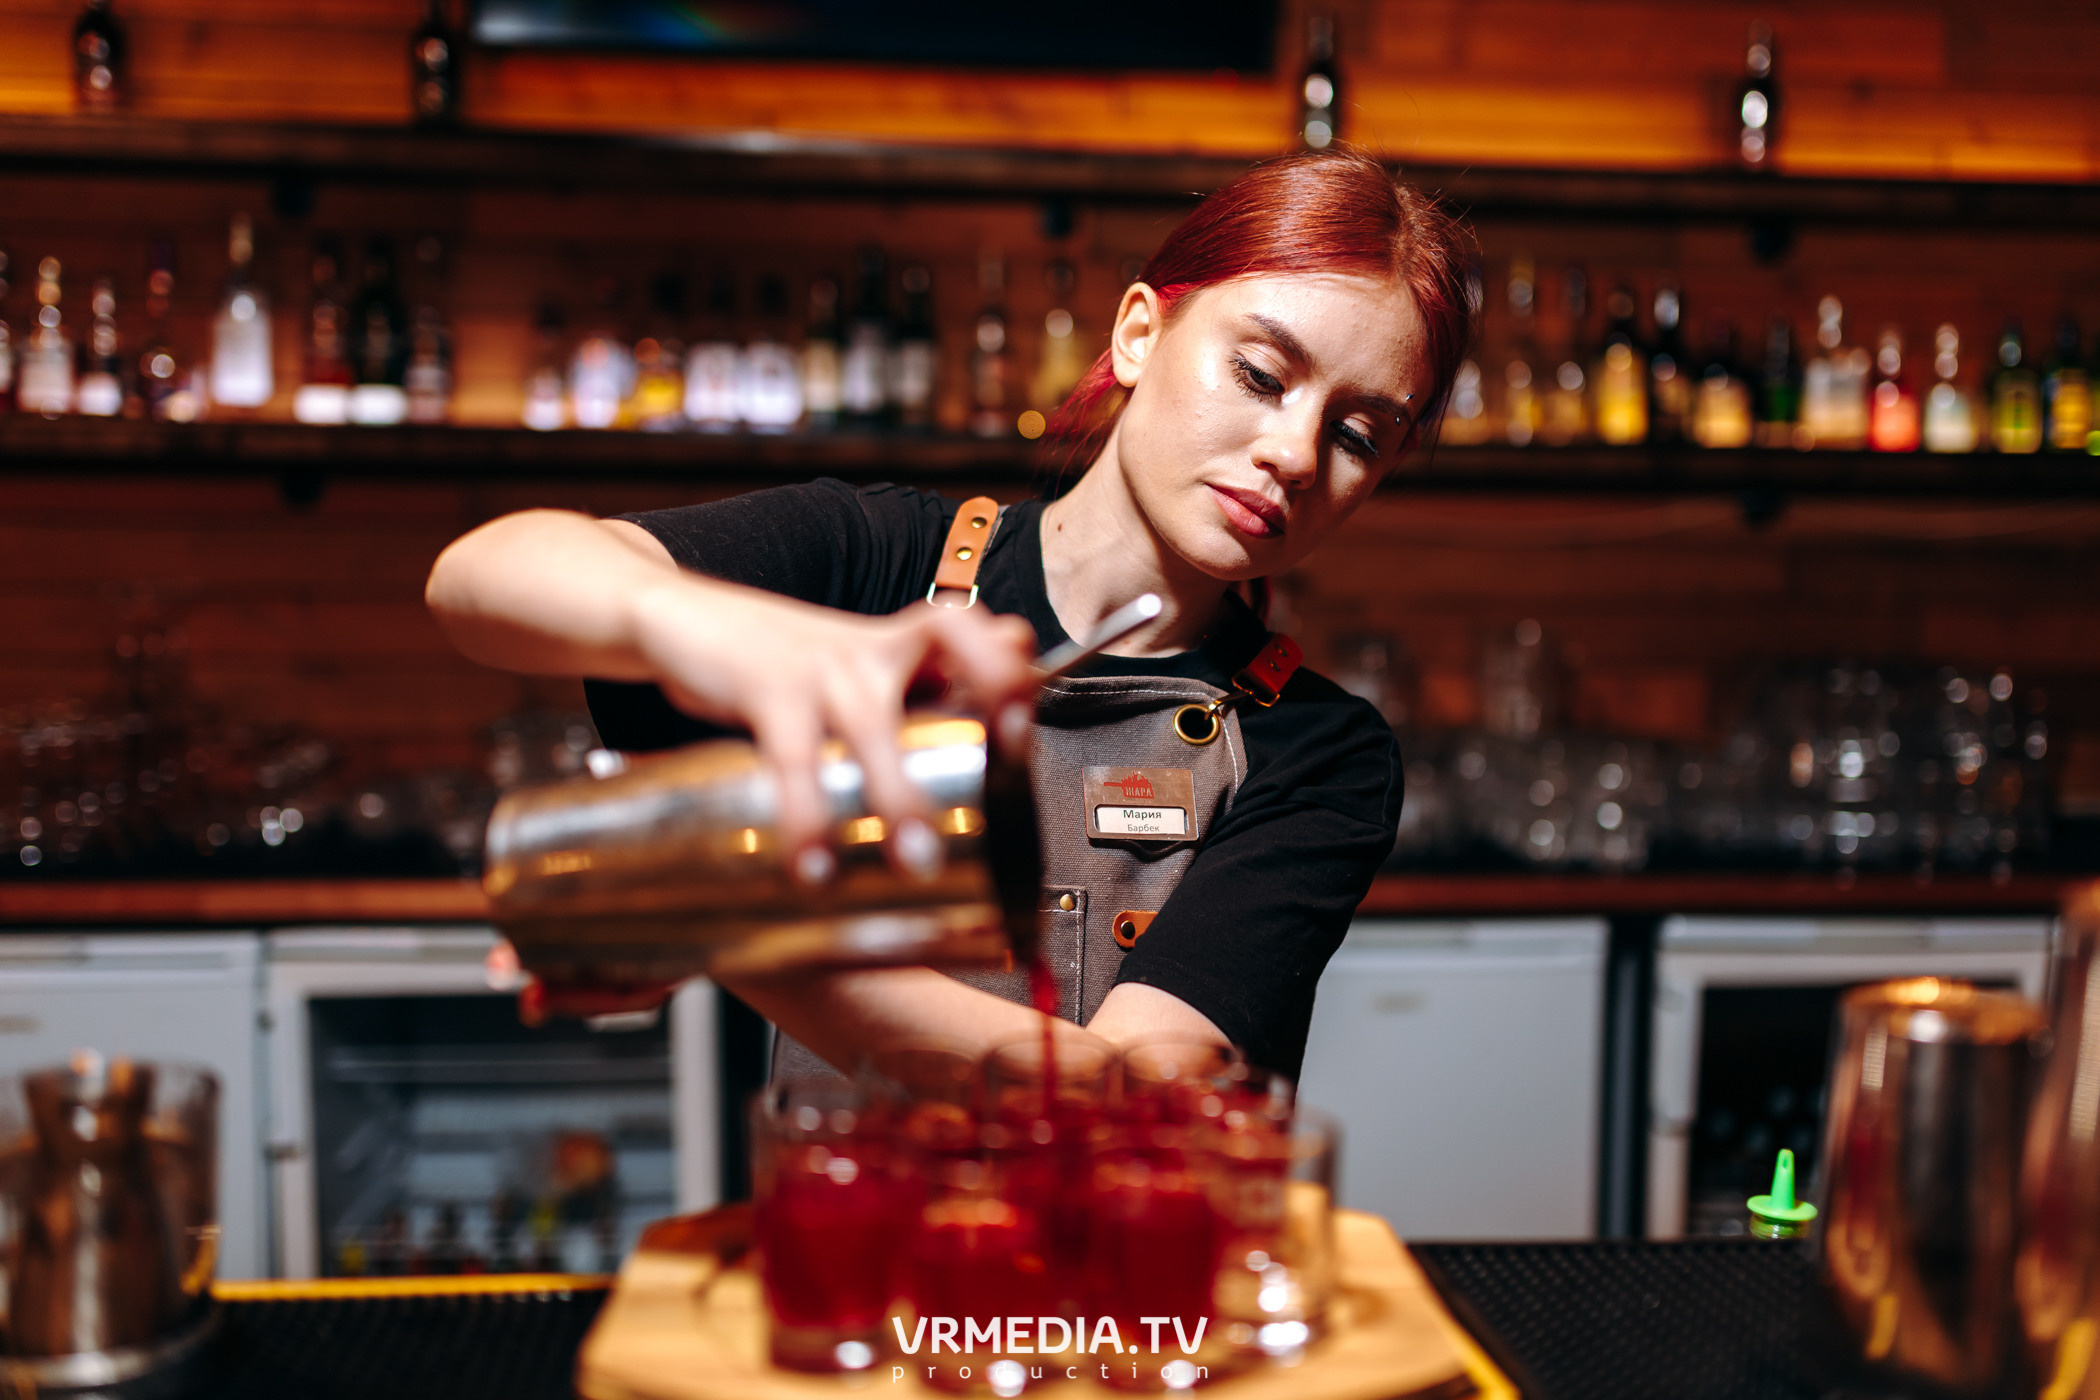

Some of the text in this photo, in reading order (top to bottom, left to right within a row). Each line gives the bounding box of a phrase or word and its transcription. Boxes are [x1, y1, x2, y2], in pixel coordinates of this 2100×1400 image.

[1125, 786, 1153, 797] ЖАРА
[1123, 809, 1162, 820] Мария
[1127, 823, 1160, 833] Барбек
